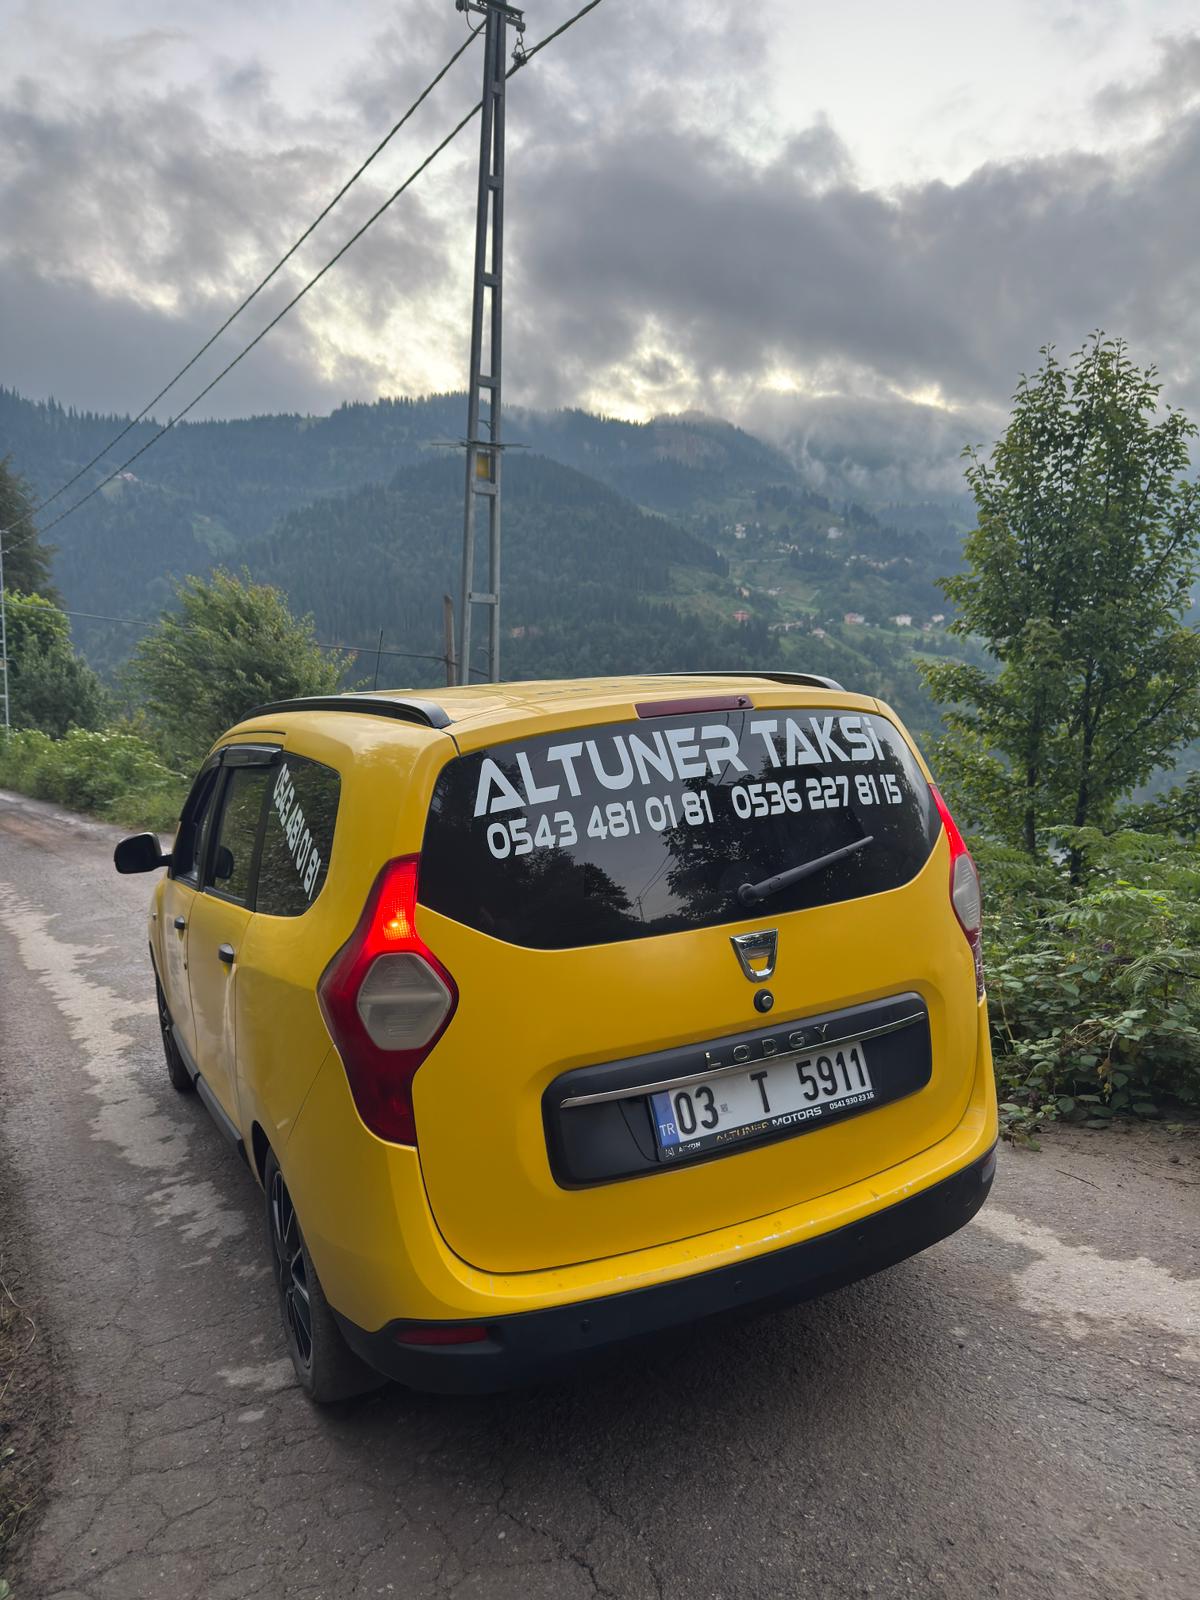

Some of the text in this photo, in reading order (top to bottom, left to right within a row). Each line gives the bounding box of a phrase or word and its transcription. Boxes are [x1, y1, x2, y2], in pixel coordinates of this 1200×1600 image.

[474, 724, 747, 817] ALTUNER
[273, 763, 321, 901] 0543 481 01 81
[487, 774, 902, 860] 0543 481 01 81 0536 227 81 15
[704, 1024, 829, 1069] LODGY
[659, 1048, 866, 1137] TR 03 T 5911
[772, 1106, 822, 1126] MOTORS
[829, 1100, 845, 1110] 0541
[858, 1094, 866, 1102] 23
